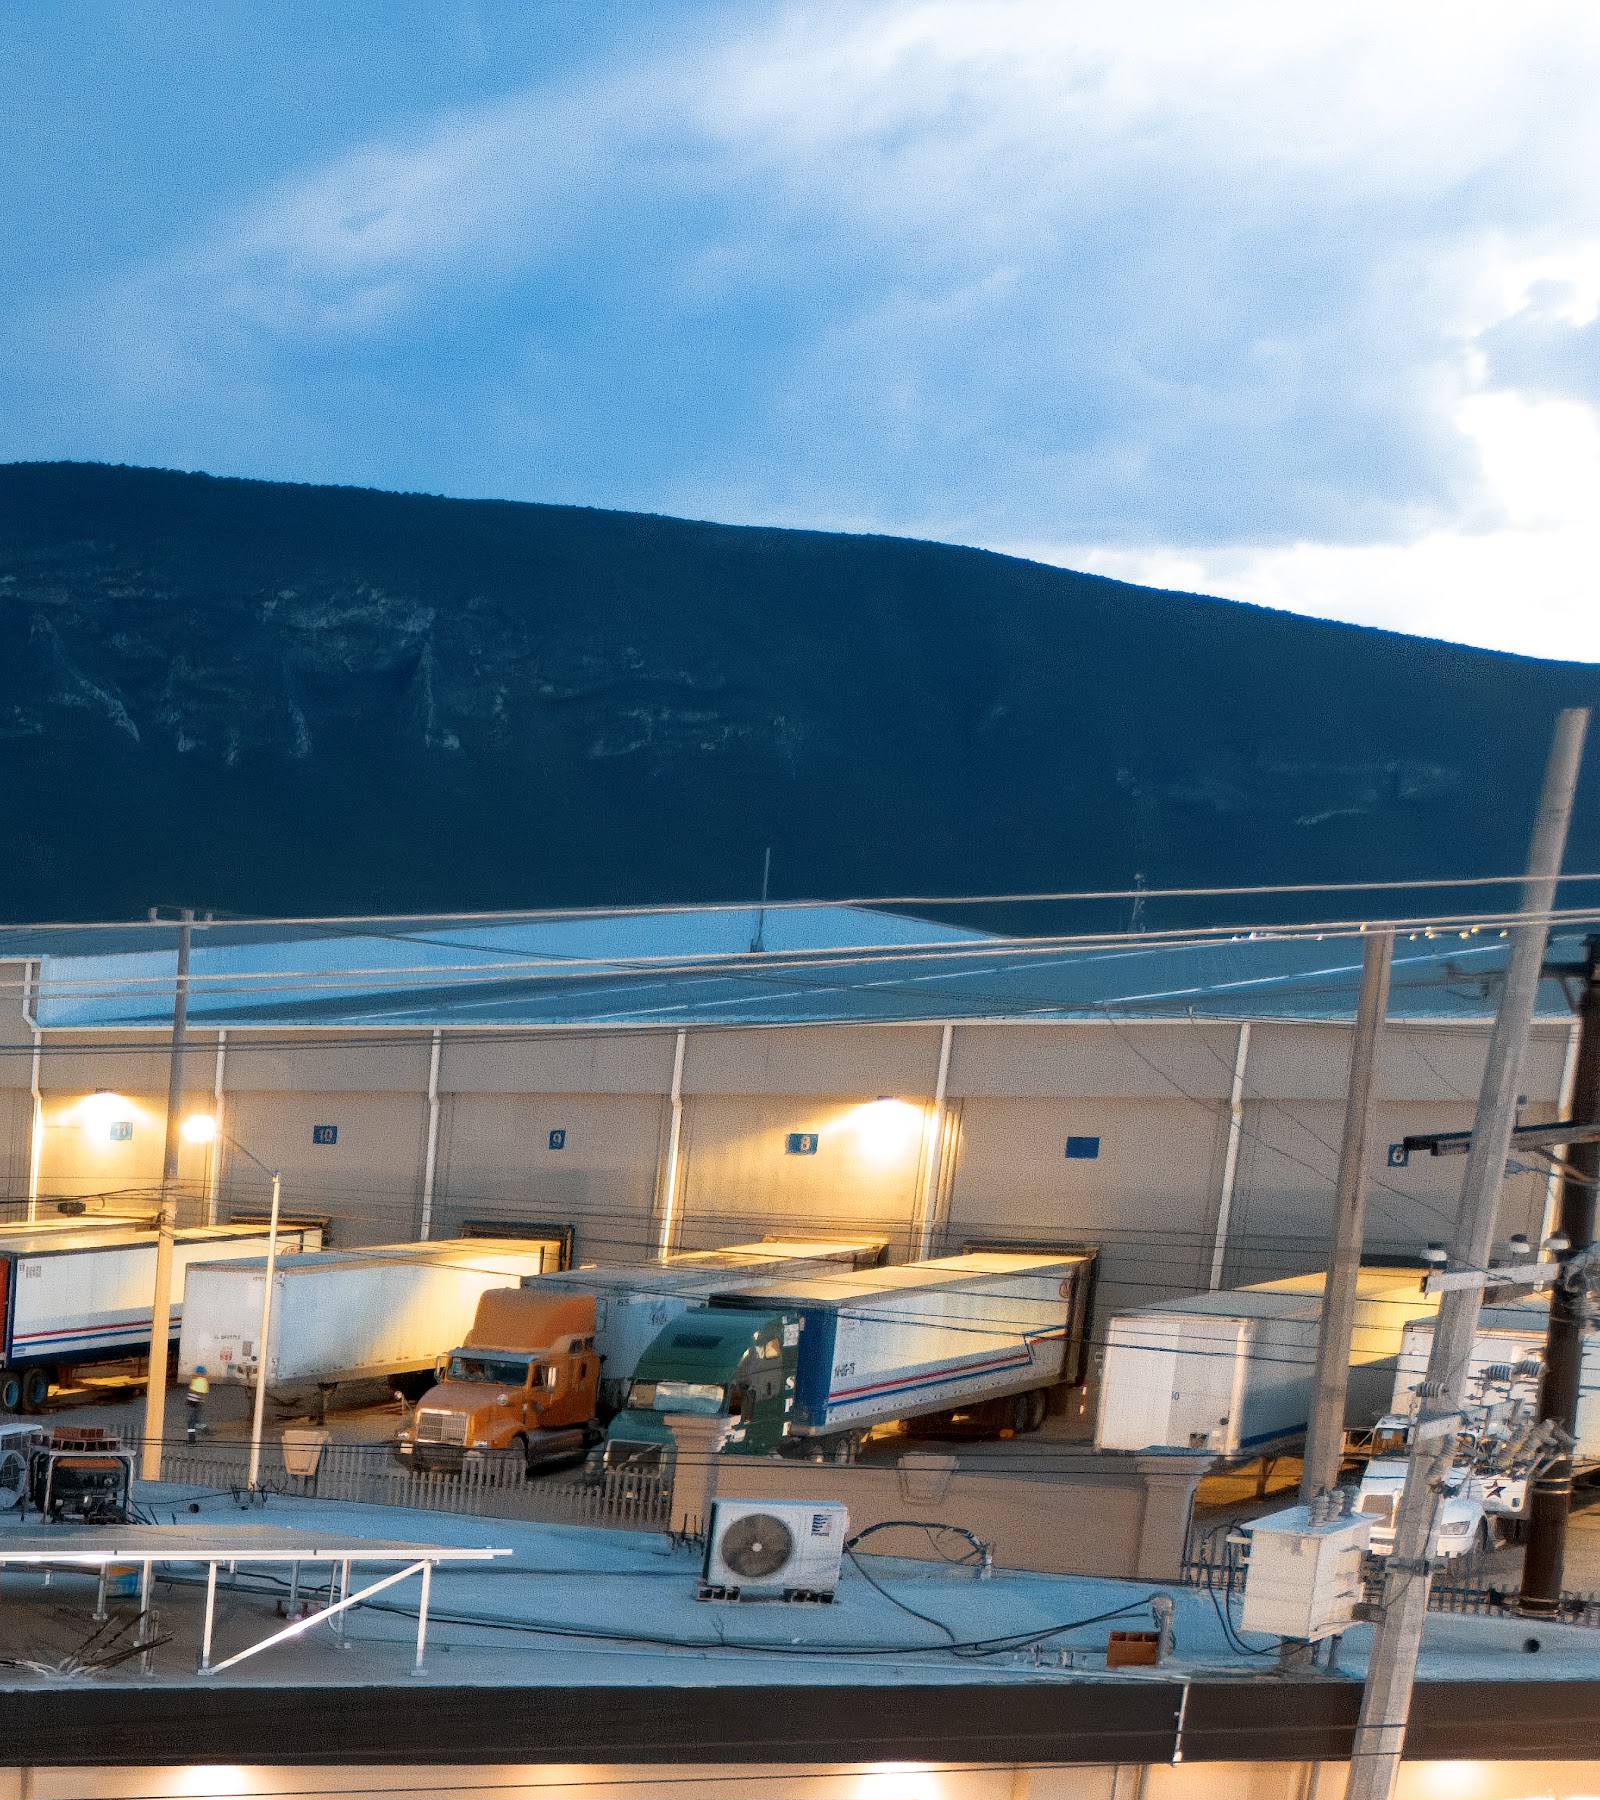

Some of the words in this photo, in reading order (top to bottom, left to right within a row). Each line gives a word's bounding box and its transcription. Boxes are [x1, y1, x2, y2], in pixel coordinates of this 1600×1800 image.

[320, 1128, 334, 1142] 10
[553, 1133, 563, 1147] 9
[801, 1135, 811, 1151] 8
